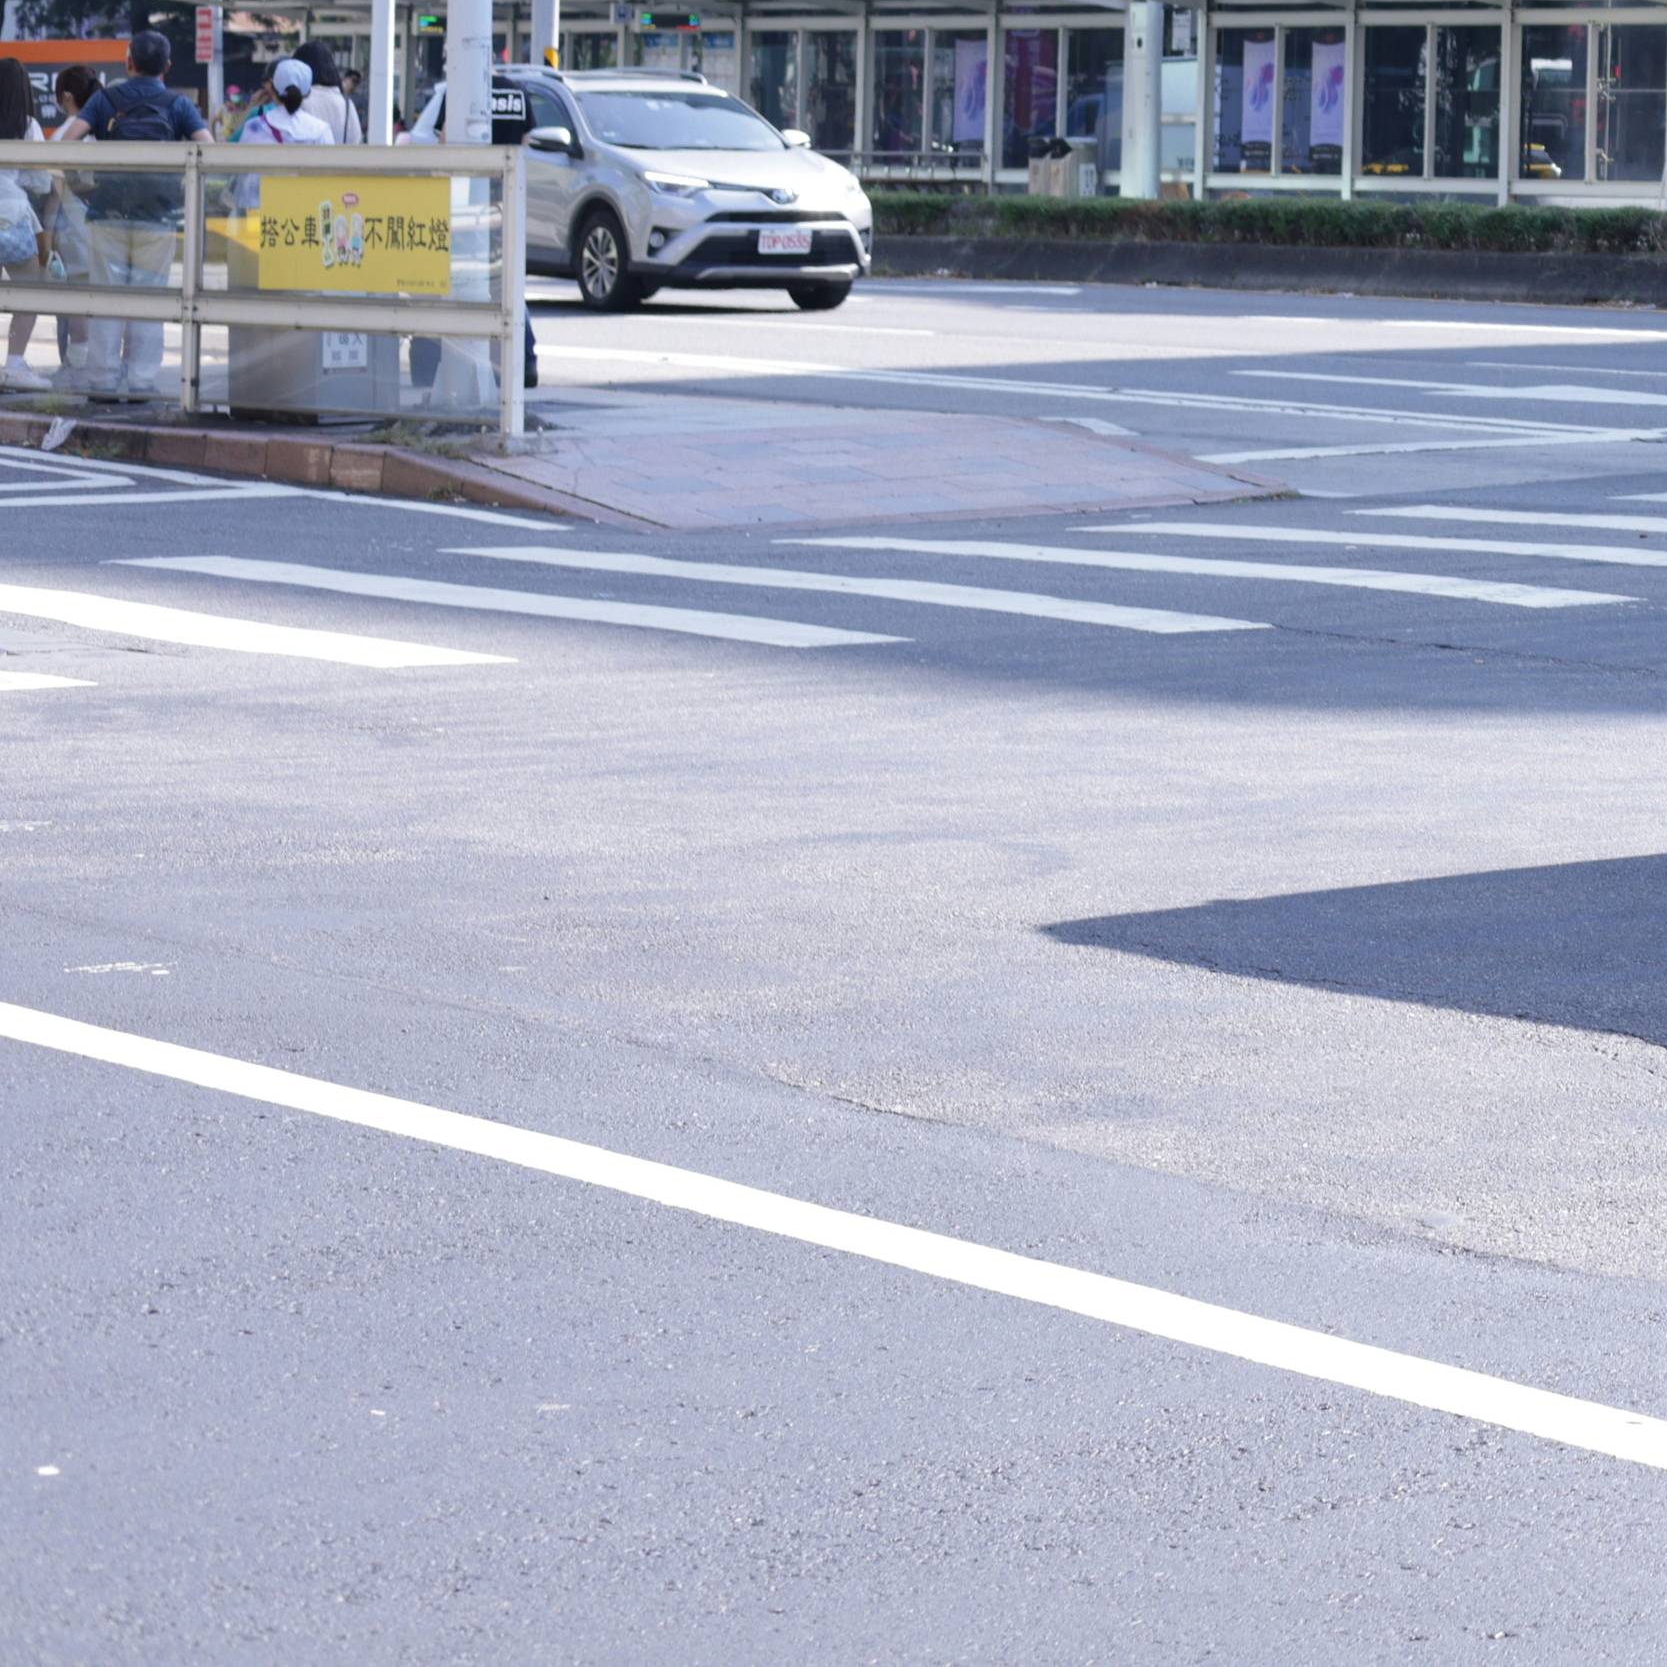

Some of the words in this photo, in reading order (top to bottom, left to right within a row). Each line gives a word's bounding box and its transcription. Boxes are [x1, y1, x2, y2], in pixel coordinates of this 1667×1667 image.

[260, 215, 320, 249] 搭公車
[364, 216, 449, 252] 不闖紅燈
